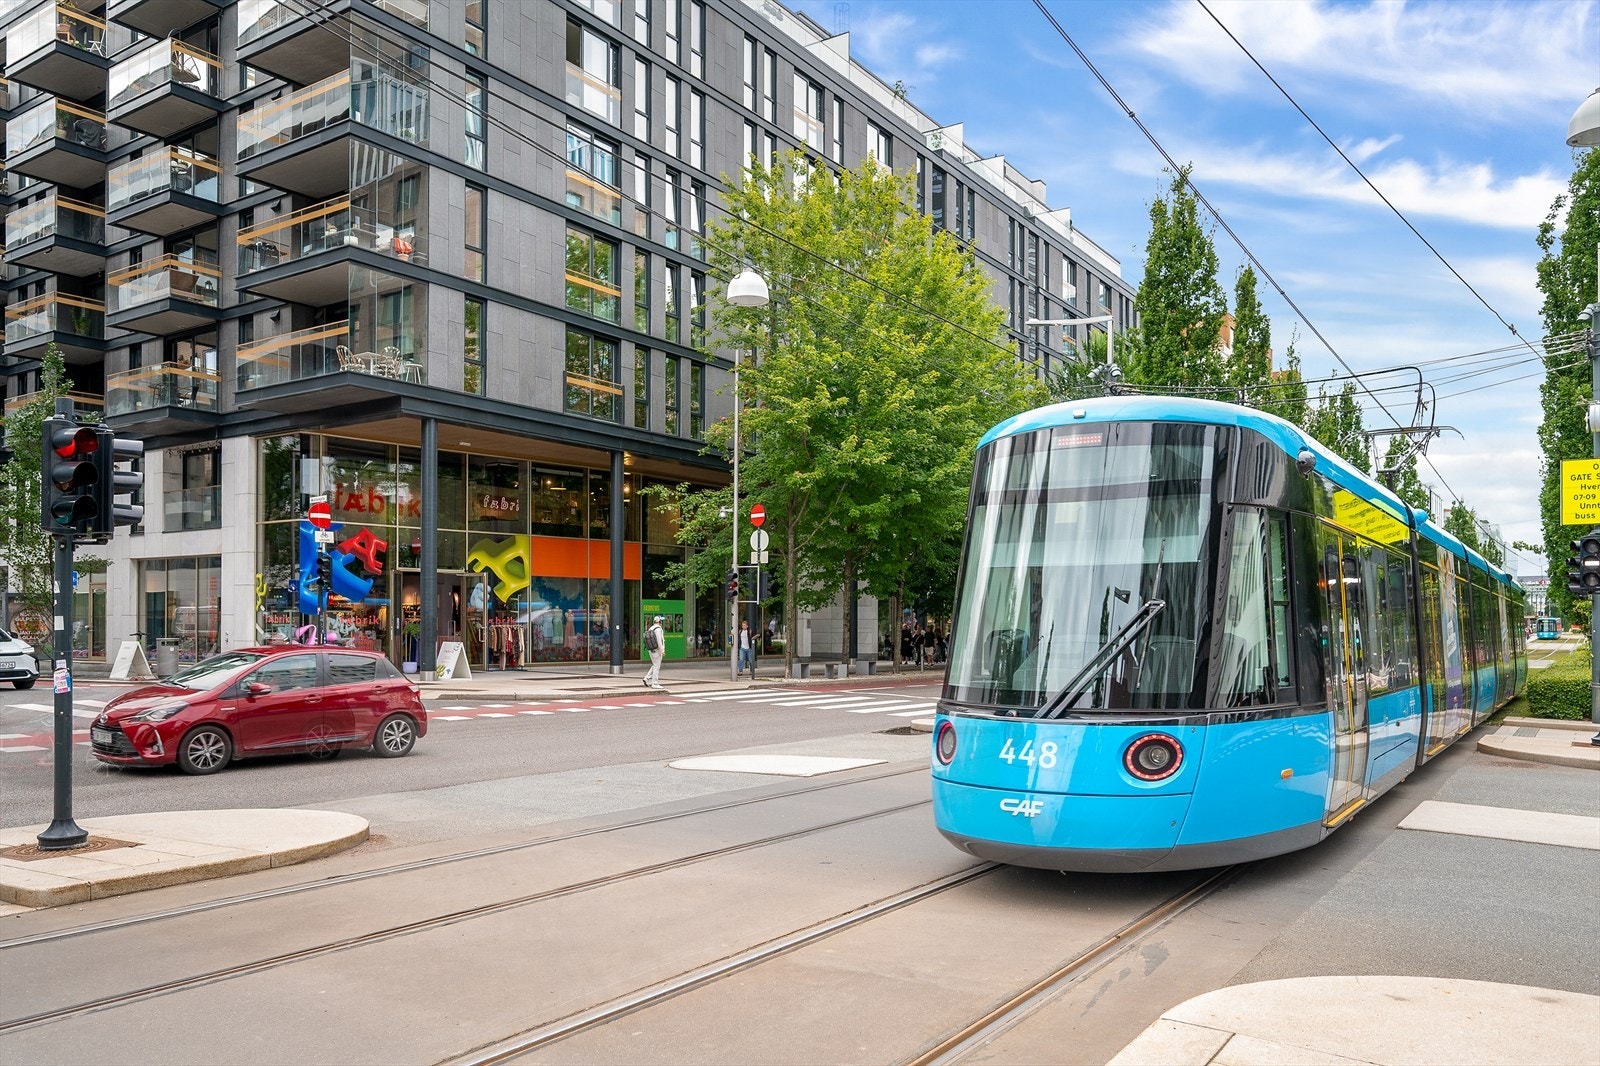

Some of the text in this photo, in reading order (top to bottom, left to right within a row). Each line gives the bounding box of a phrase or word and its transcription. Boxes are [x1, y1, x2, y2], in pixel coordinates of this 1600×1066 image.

[1570, 473, 1592, 481] GATE
[999, 738, 1058, 769] 448
[1000, 798, 1044, 817] CAF
